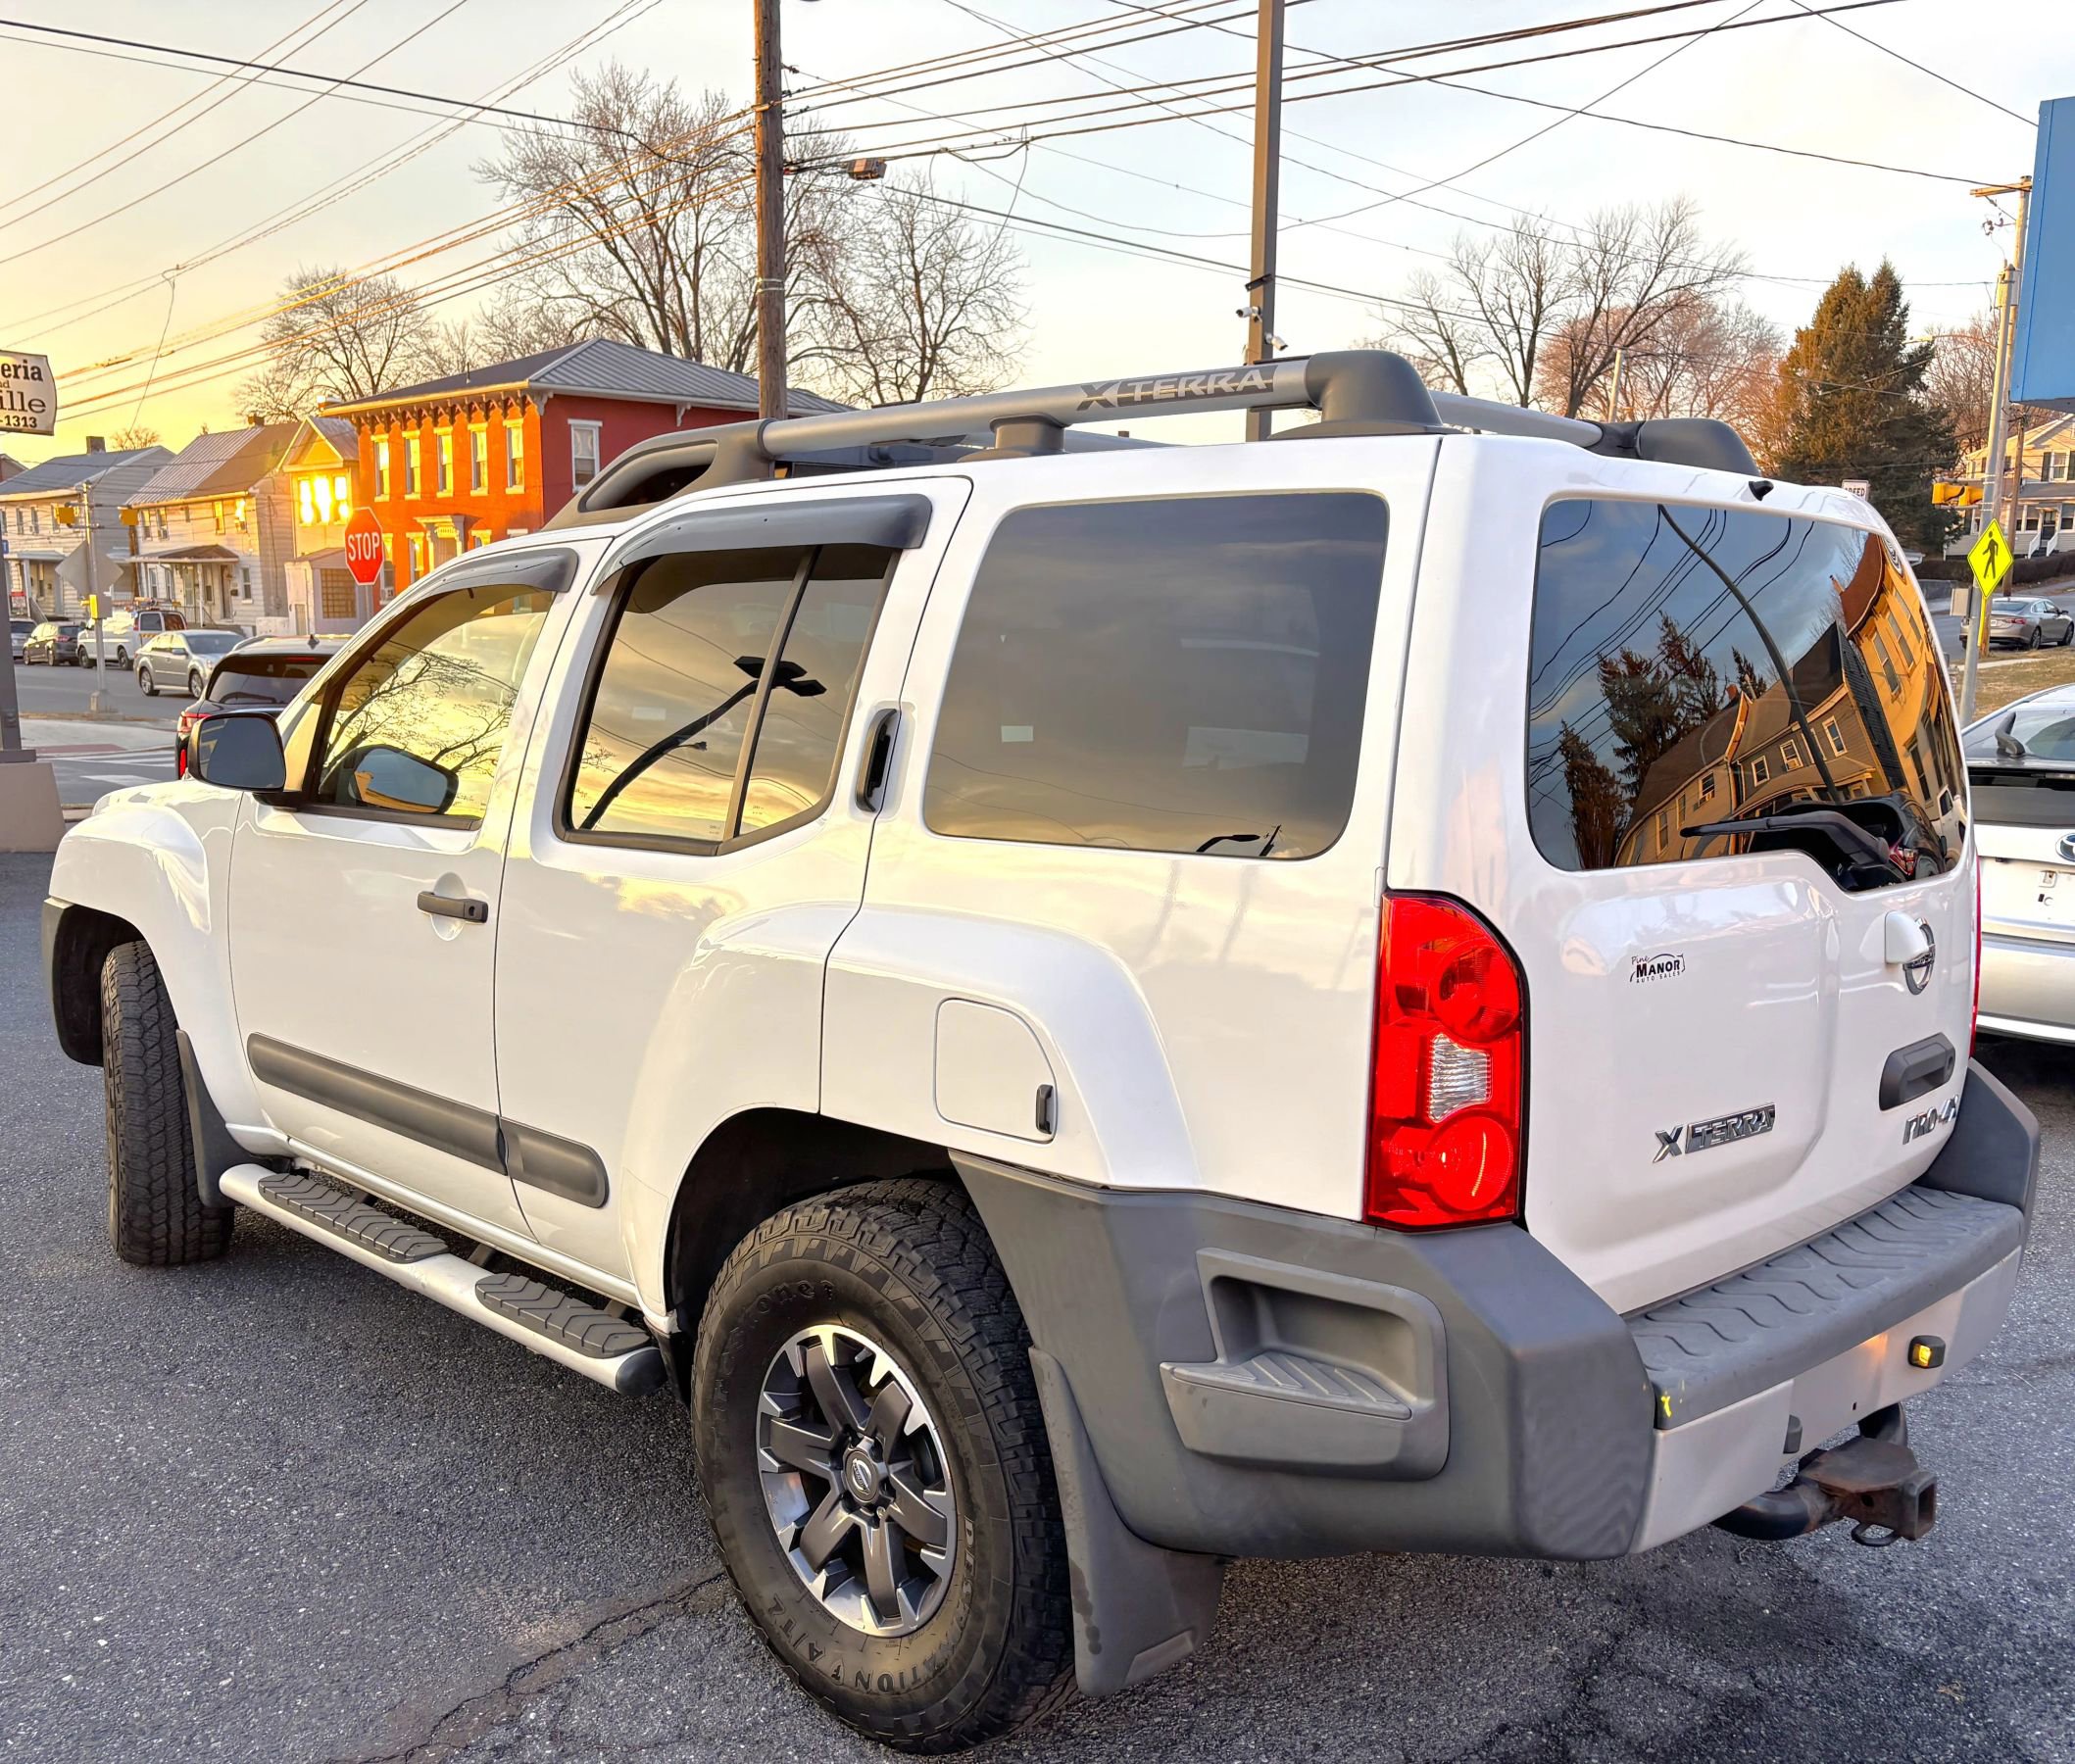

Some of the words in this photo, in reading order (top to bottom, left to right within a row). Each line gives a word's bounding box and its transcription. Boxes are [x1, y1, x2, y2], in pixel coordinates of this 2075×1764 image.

[1076, 368, 1268, 412] XTERRA
[348, 532, 379, 562] STOP
[1636, 959, 1680, 978] MANOR
[1636, 975, 1655, 984] AUTO
[1659, 970, 1680, 980] SALES
[1653, 1107, 1774, 1163] XTERRA
